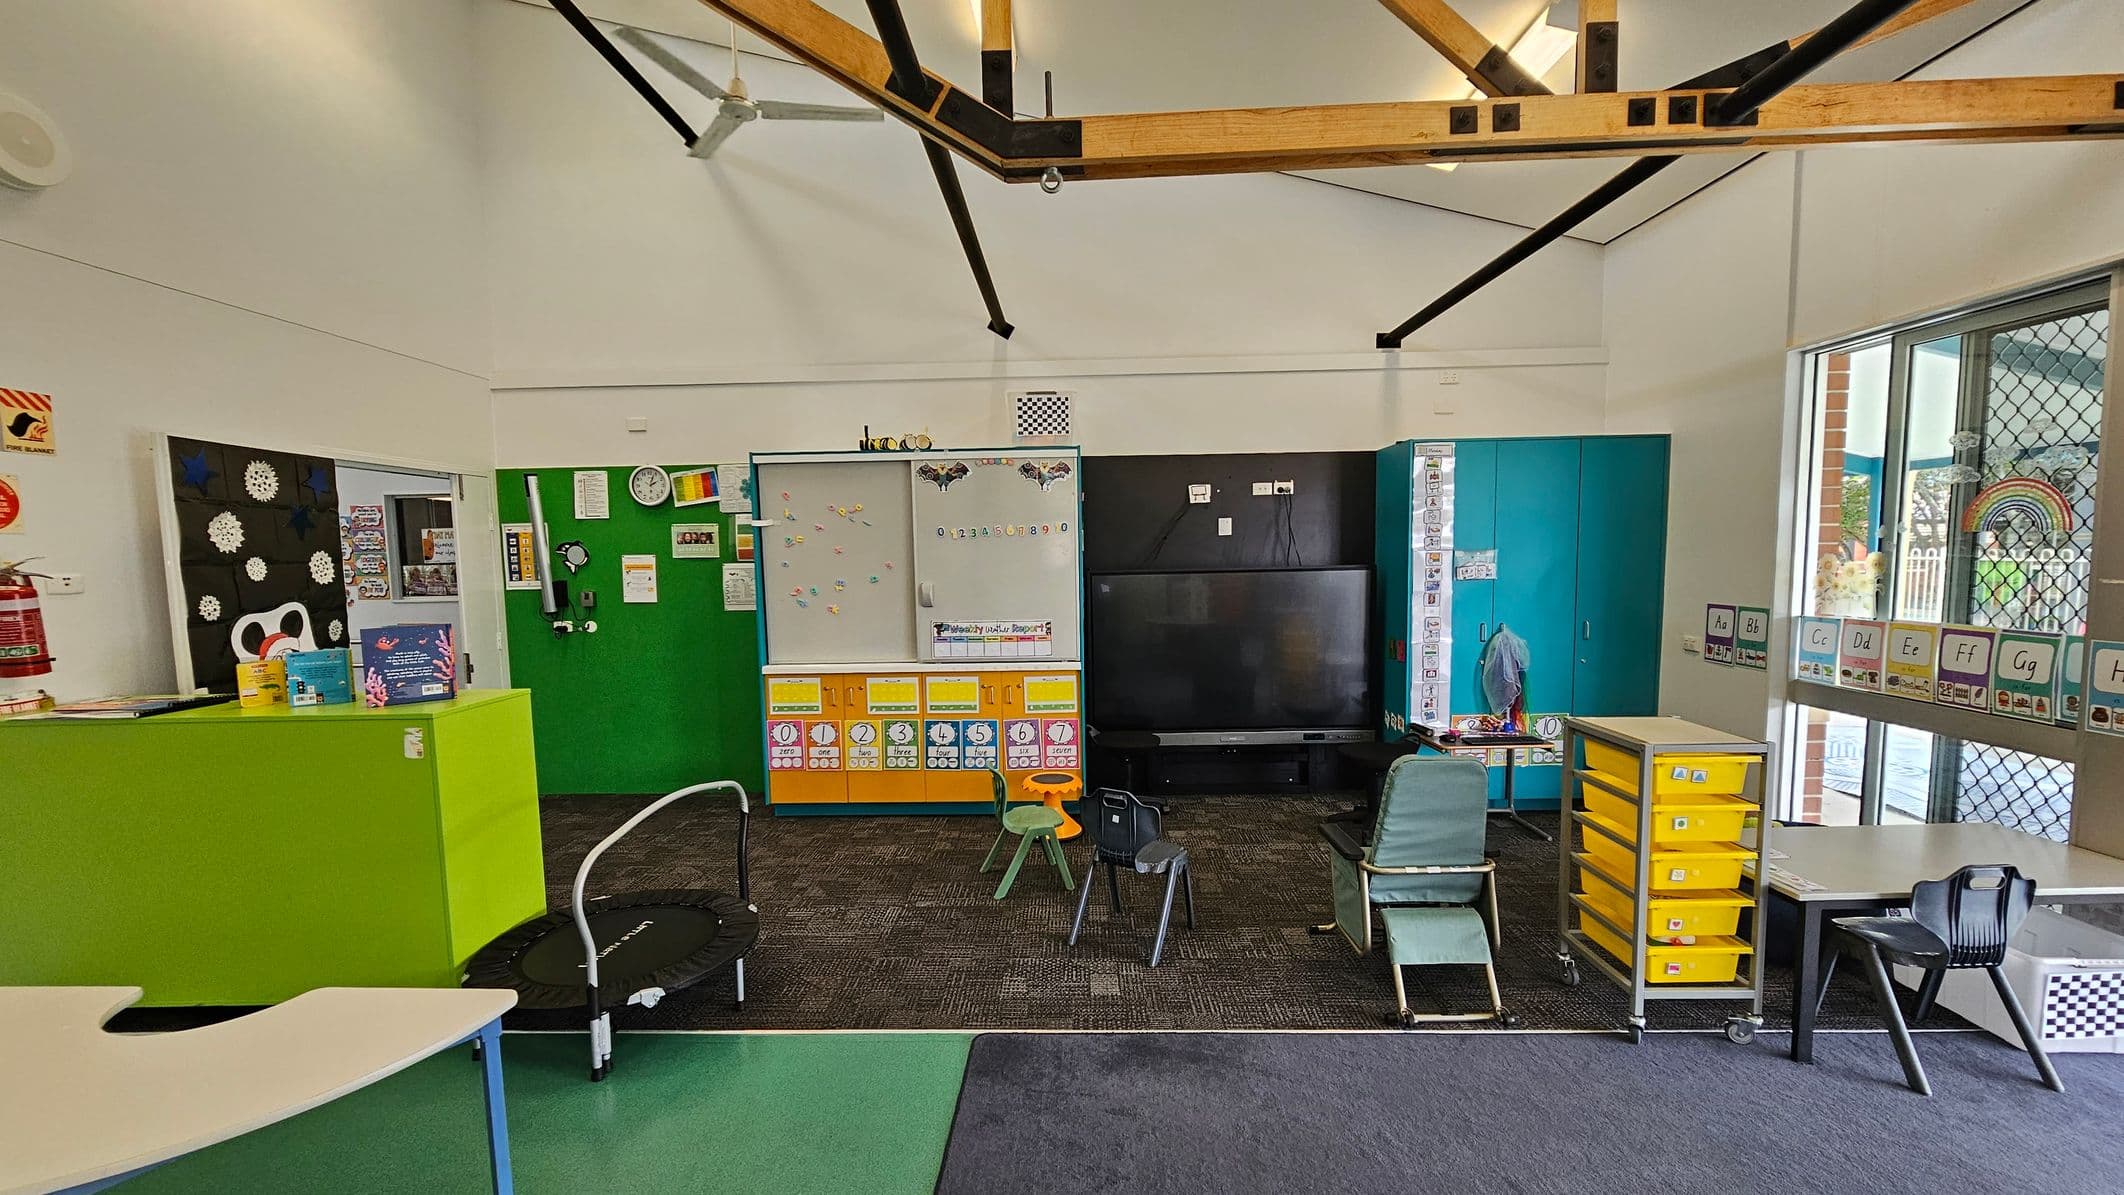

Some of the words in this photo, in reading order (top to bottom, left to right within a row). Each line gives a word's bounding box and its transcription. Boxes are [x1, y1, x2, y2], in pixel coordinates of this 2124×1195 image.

[24, 446, 56, 454] BLANKET
[937, 527, 945, 537] 0
[950, 528, 958, 540] 1
[959, 528, 966, 538] 2
[970, 528, 977, 538] 3
[981, 527, 989, 537] 4
[994, 526, 1002, 536] 5
[1006, 526, 1015, 536] 6
[1018, 526, 1025, 535] 7
[1030, 526, 1037, 535] 8
[1042, 525, 1049, 534] 9
[1055, 521, 1068, 534] 10
[950, 624, 984, 635] Weekly
[1011, 623, 1044, 634] Report
[1715, 614, 1727, 630] Aa
[1746, 618, 1759, 633] Bb
[1812, 628, 1828, 646] Cc
[1853, 631, 1872, 650] Dd
[1902, 637, 1919, 656] Ee
[1956, 643, 1978, 663] Ff
[2013, 650, 2037, 680] Gg
[780, 725, 792, 742] 0
[821, 725, 826, 742] 1
[858, 725, 868, 742] 2
[897, 724, 906, 741] 3
[938, 725, 947, 742] 4
[975, 724, 985, 742] 5
[1018, 723, 1027, 740] 6
[1056, 724, 1066, 742] 7
[1543, 718, 1557, 735] 10
[858, 744, 872, 756] two
[894, 745, 912, 756] three
[935, 744, 951, 756] four
[974, 744, 987, 756] five
[1052, 747, 1072, 755] seven
